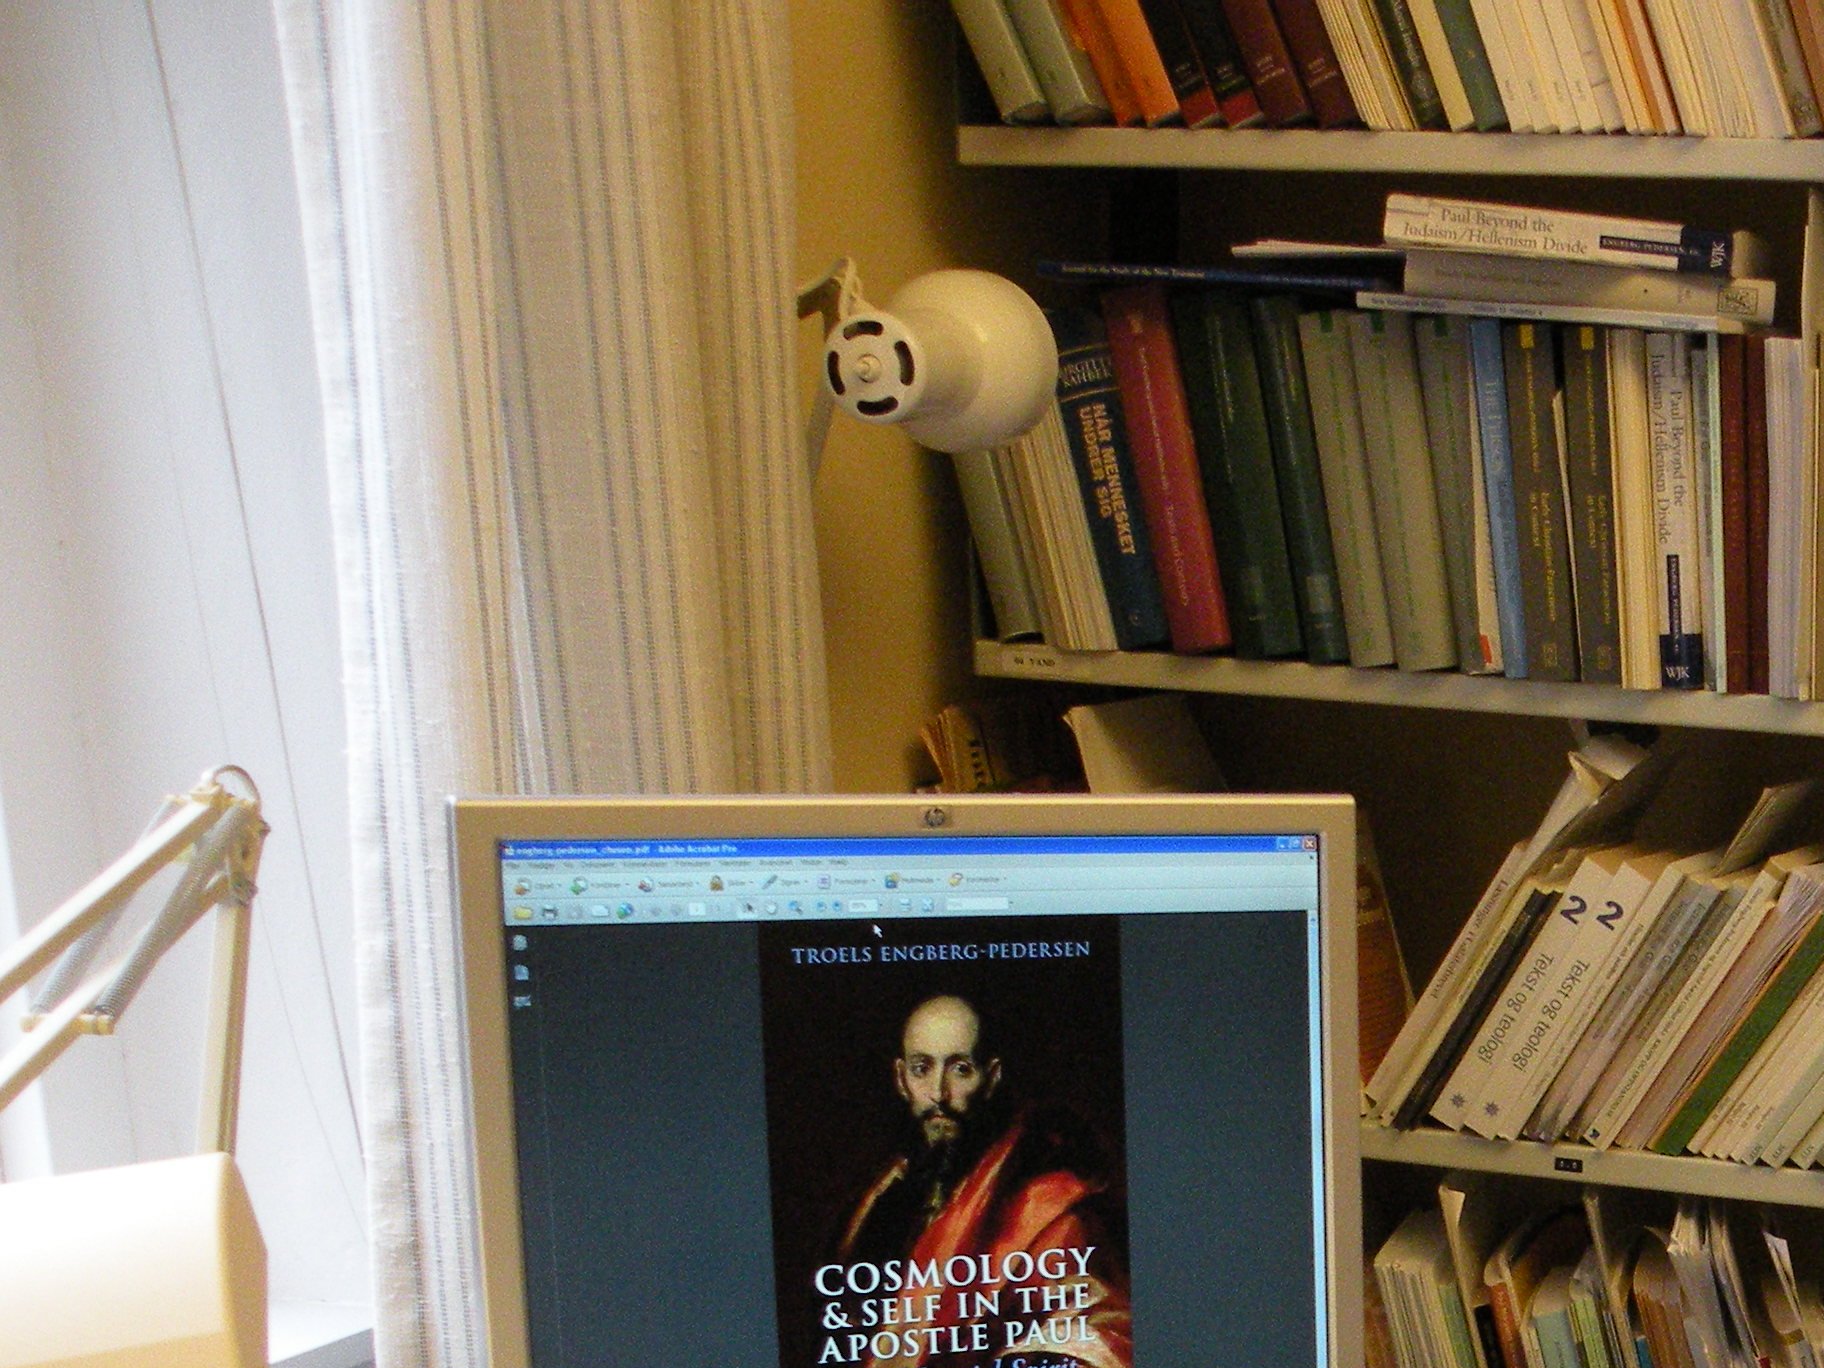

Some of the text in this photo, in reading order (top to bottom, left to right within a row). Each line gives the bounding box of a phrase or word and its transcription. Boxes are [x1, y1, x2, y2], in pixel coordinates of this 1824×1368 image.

[1402, 221, 1588, 256] Judaism/Hellenism Divide
[1440, 208, 1554, 232] Paul Beyond the
[1710, 241, 1725, 269] WJK
[1670, 390, 1687, 507] Paul Beyond the
[1101, 446, 1136, 554] MENNESKET
[1659, 499, 1672, 543] Divide
[1665, 665, 1690, 678] WJK
[1559, 893, 1589, 925] 2
[1595, 899, 1625, 931] 2
[792, 941, 1090, 964] TROELS ENGBERG-PEDERSEN
[1474, 950, 1555, 1066] Tekst og teologi
[1508, 957, 1590, 1073] Tekst og teologi
[814, 1246, 1096, 1297] COSMOLOGY
[822, 1283, 1090, 1330] & SELF IN THE
[818, 1316, 1096, 1364] APOSTLE PAUL
